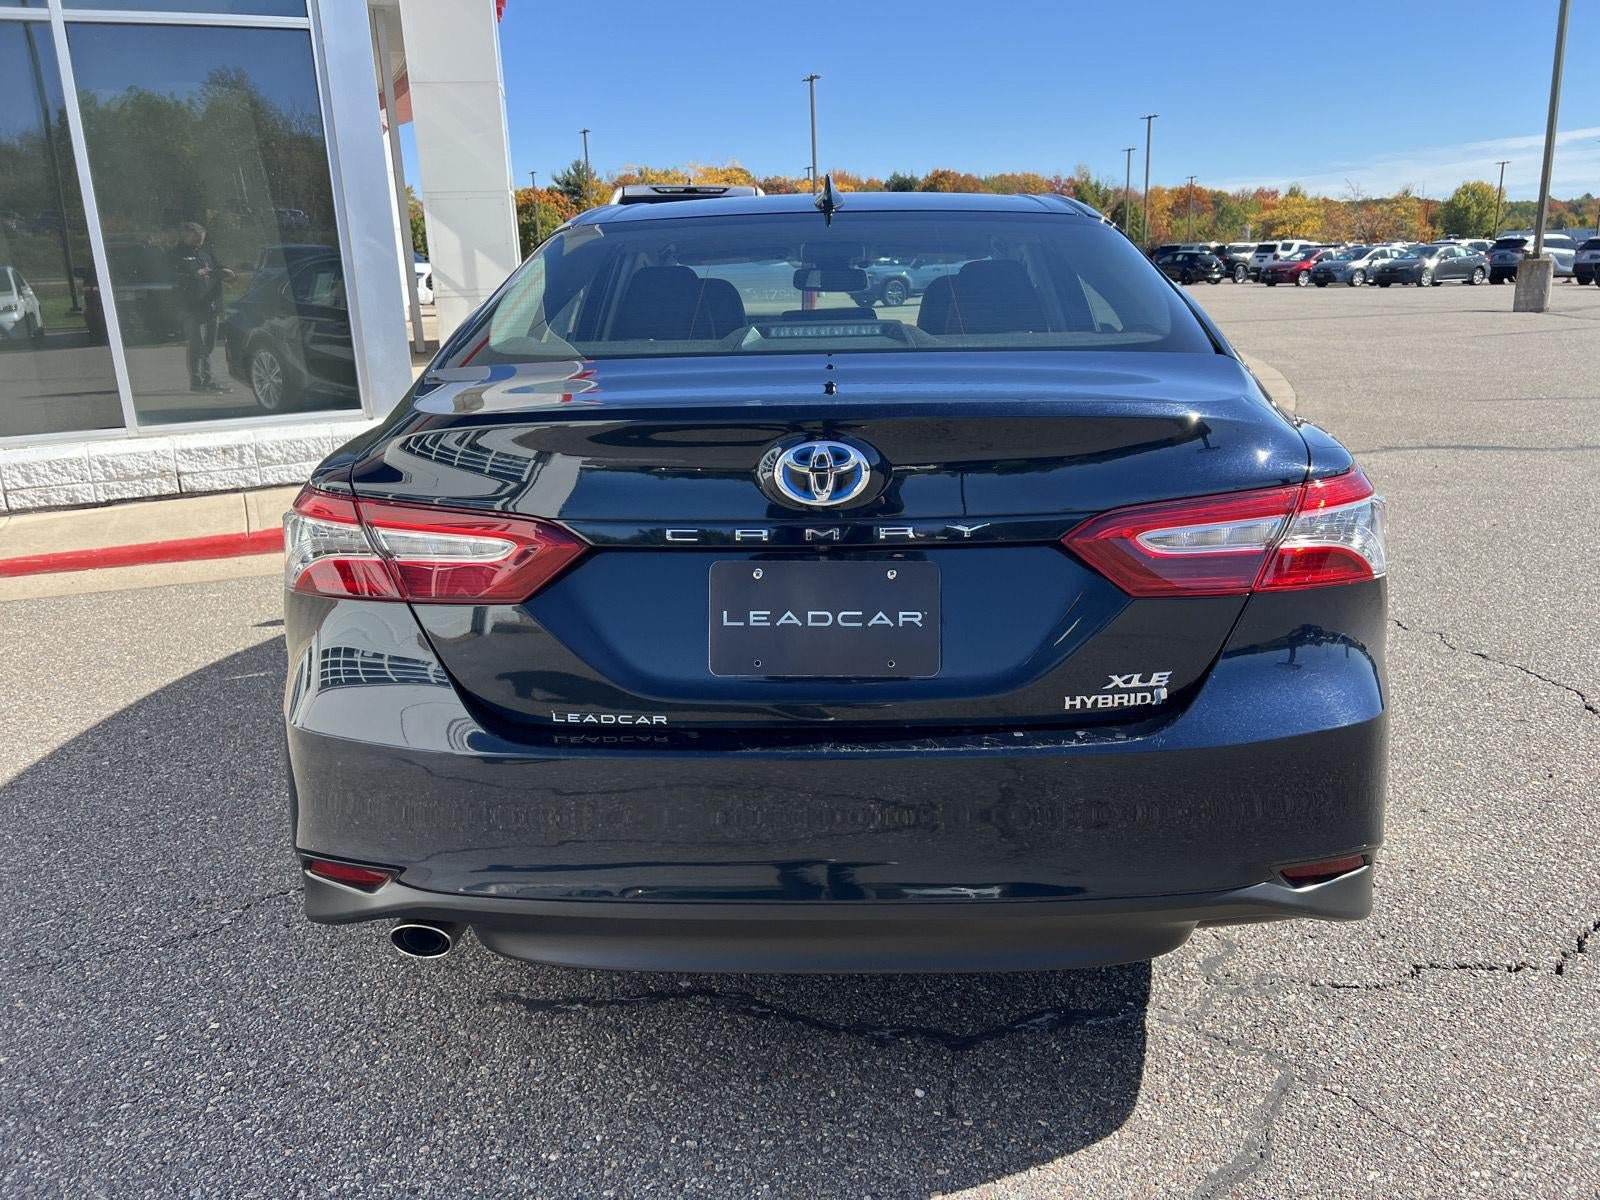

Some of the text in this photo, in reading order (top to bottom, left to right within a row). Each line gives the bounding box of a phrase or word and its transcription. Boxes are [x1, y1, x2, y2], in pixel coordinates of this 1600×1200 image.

[665, 522, 991, 541] CAMRY
[722, 610, 923, 628] LEADCAR
[1101, 670, 1173, 690] XLE
[1063, 691, 1153, 711] HYBRID
[551, 711, 668, 725] LEADCAR
